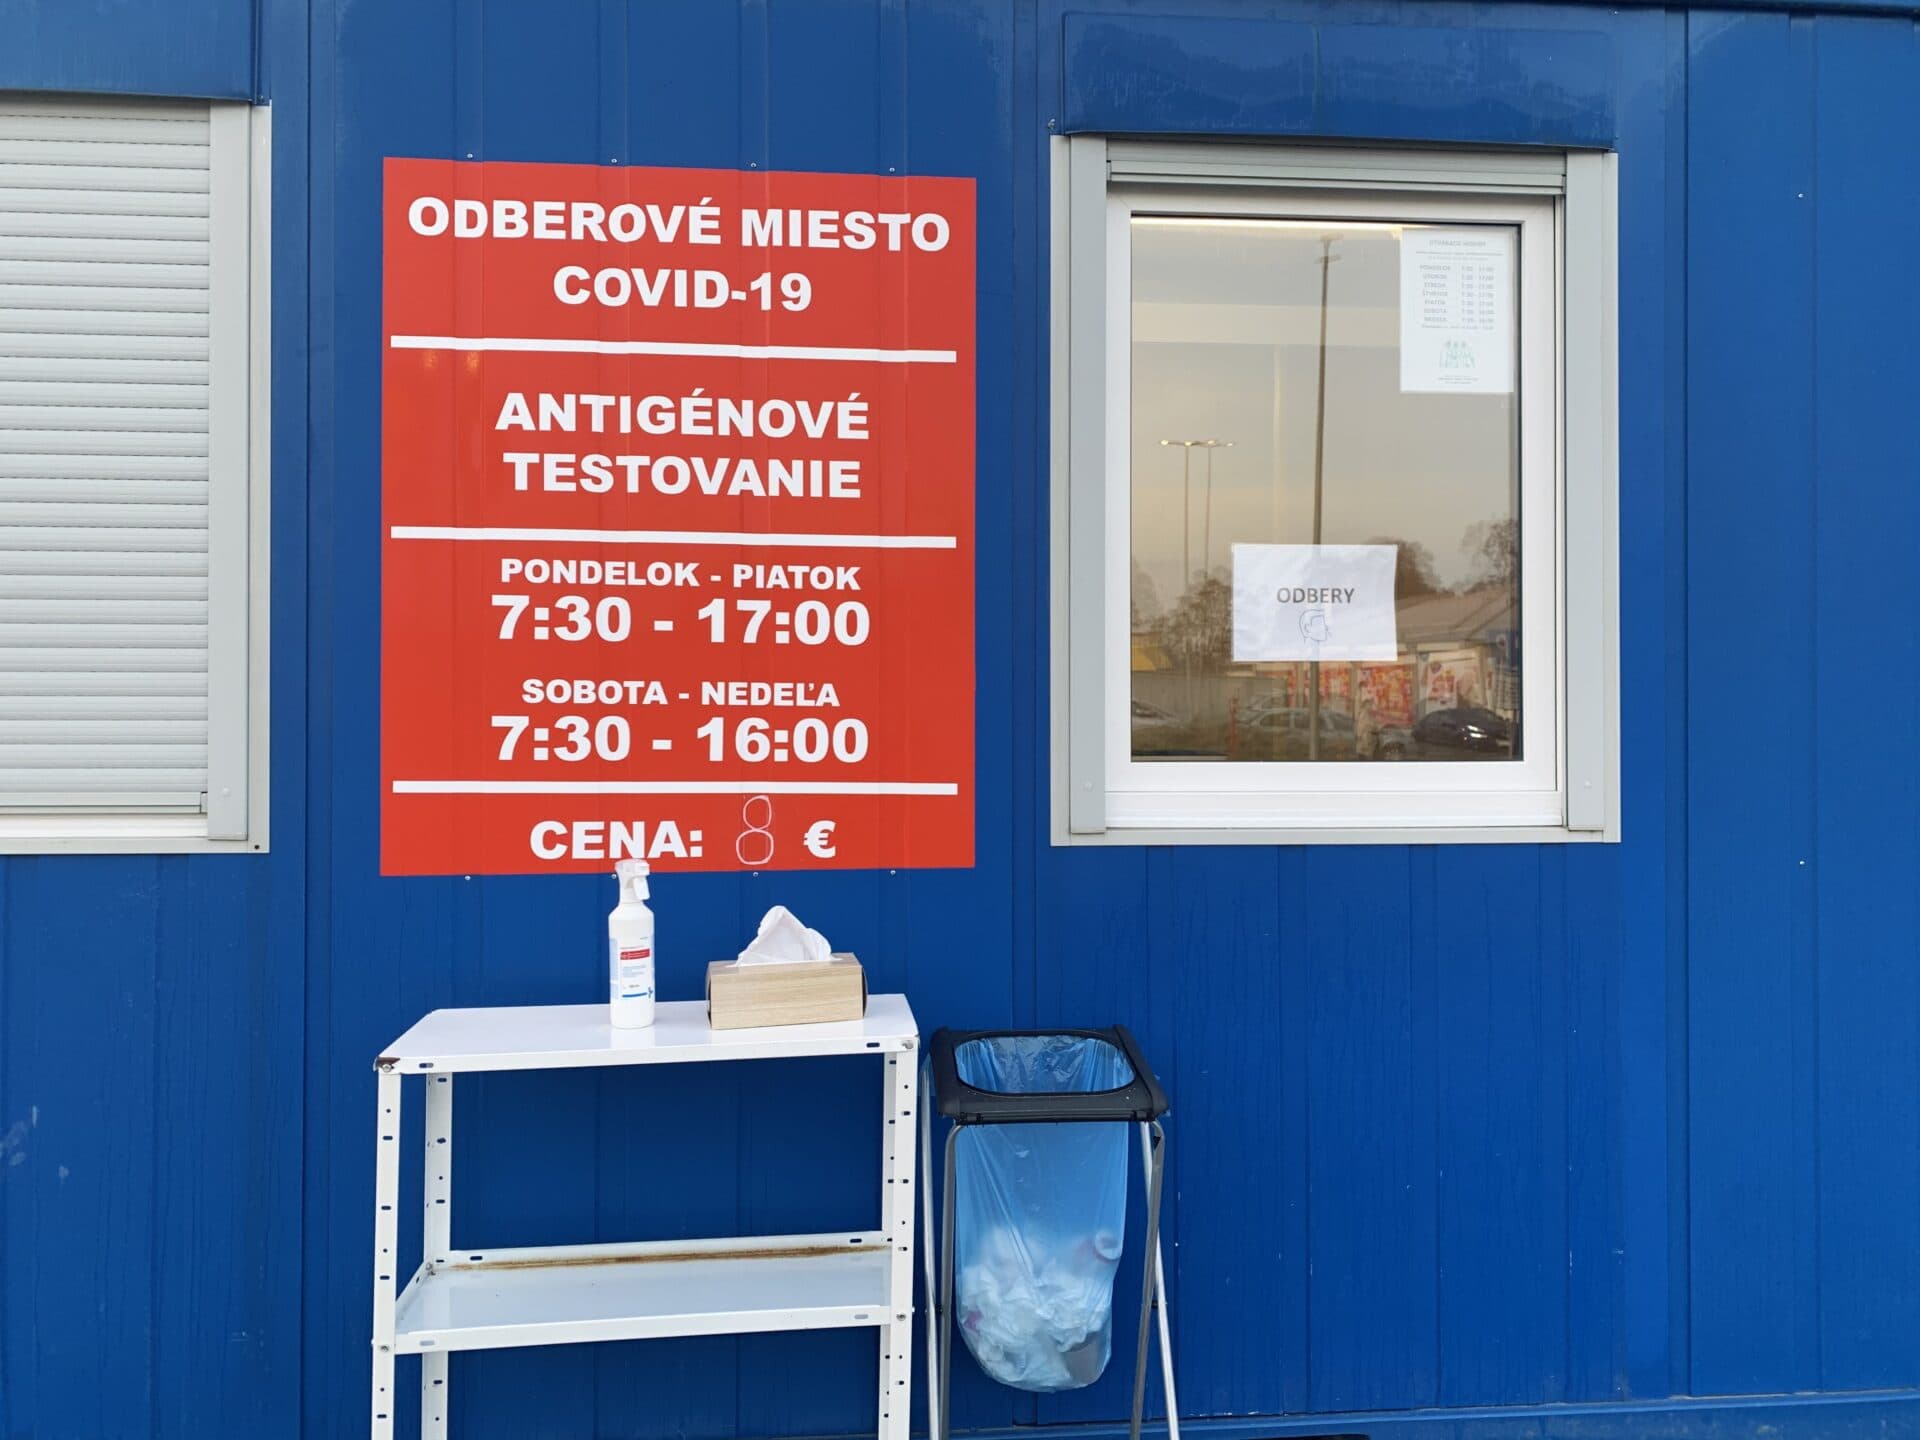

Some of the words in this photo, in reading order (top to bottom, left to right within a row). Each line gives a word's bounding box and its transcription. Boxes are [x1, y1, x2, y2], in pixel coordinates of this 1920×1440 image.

[408, 196, 722, 245] ODBEROVÉ
[741, 208, 950, 252] MIESTO
[553, 265, 812, 312] COVID-19
[495, 388, 869, 440] ANTIGÉNOVÉ
[503, 452, 861, 499] TESTOVANIE
[501, 558, 700, 587] PONDELOK
[710, 574, 722, 582] -
[733, 563, 861, 591] PIATOK
[1277, 587, 1355, 604] ODBERY
[491, 594, 632, 642] 7:30
[653, 620, 674, 631] -
[698, 598, 870, 646] 17:00
[522, 678, 668, 705] SOBOTA
[678, 692, 690, 700] -
[701, 681, 841, 707] NEDEĽA
[491, 715, 631, 762] 7:30
[652, 739, 672, 751] -
[697, 716, 869, 763] 16:00
[530, 820, 703, 860] CENA:
[735, 794, 775, 866] 8
[803, 820, 836, 859] €
